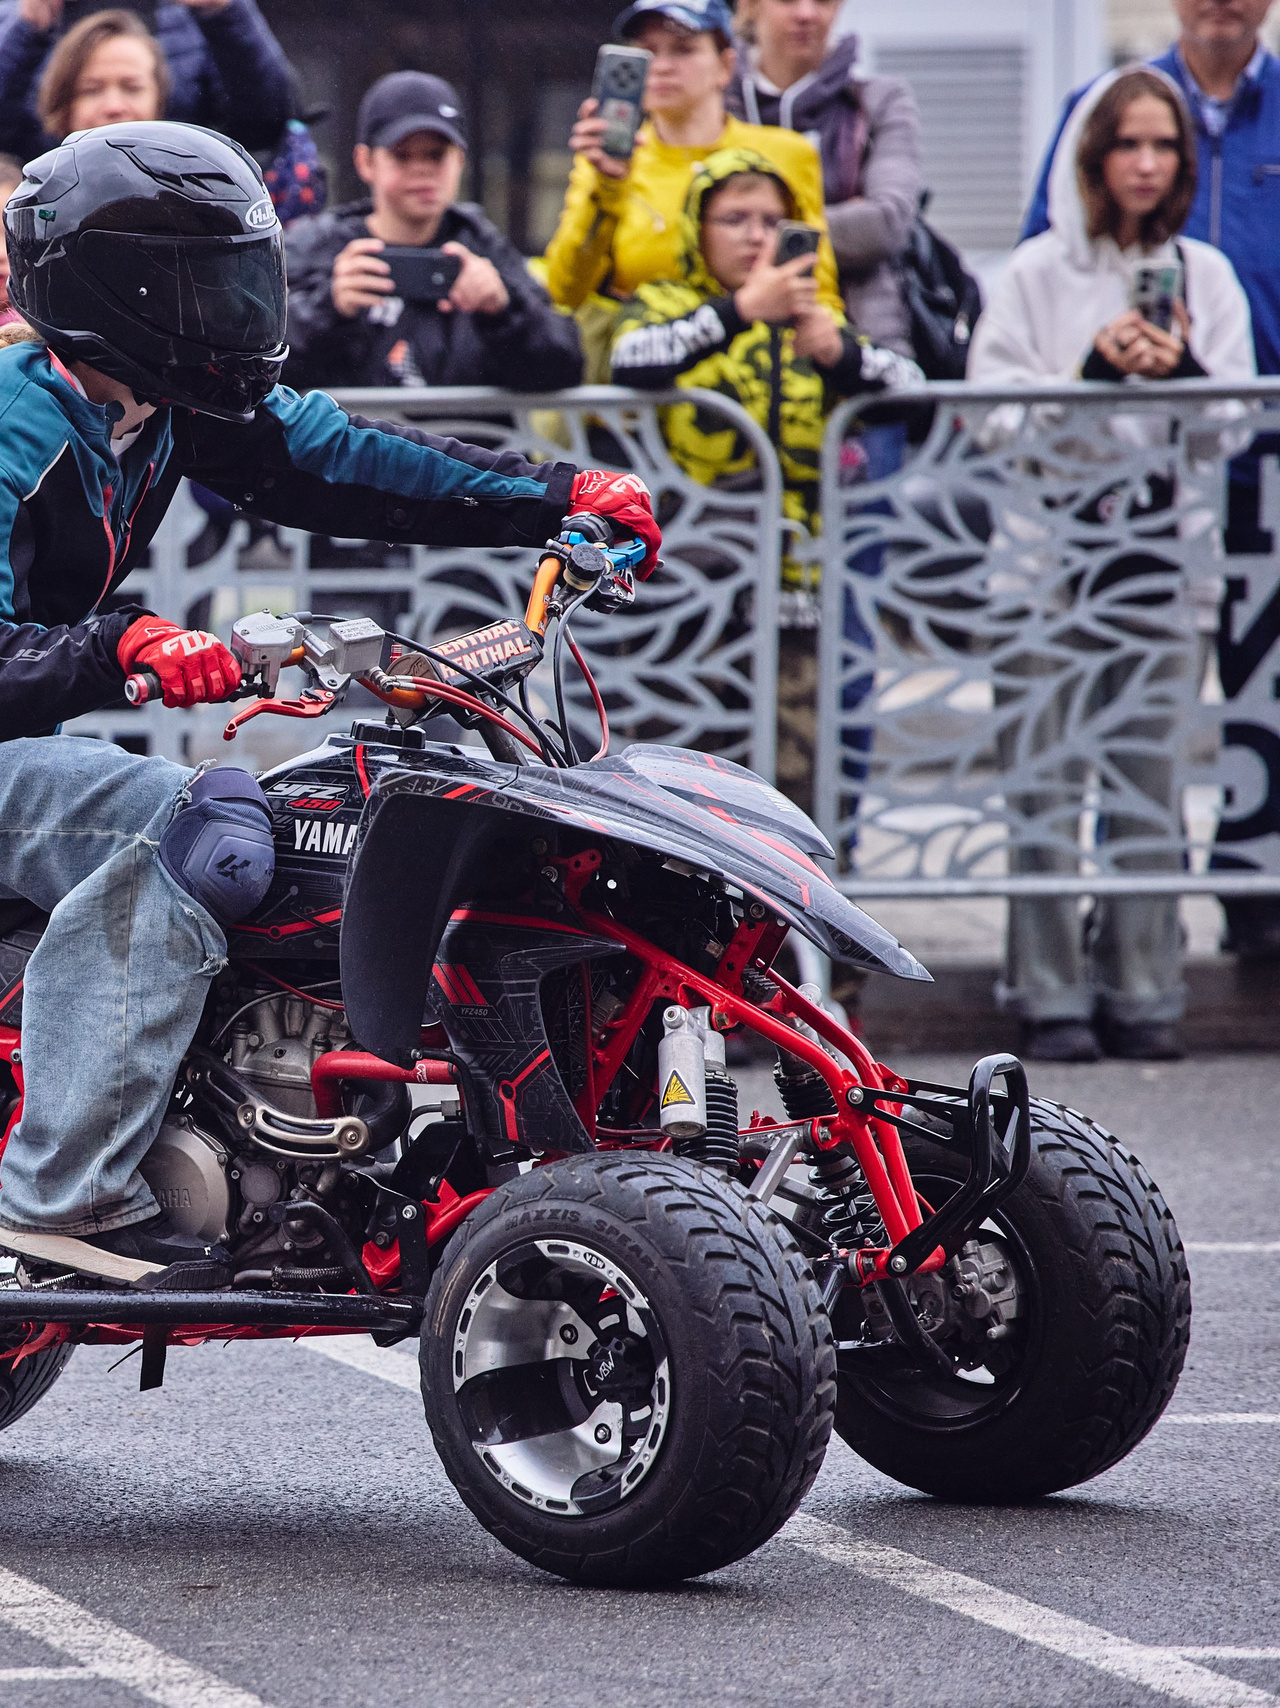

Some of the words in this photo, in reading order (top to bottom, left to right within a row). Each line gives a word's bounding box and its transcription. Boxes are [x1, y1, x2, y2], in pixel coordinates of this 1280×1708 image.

[609, 473, 652, 498] FO
[162, 629, 222, 657] FOX
[431, 621, 521, 657] ENTHAL
[265, 782, 348, 800] YFZ
[287, 798, 343, 811] 450
[461, 1007, 489, 1016] YFZ450
[154, 1188, 192, 1208] AHA
[504, 1208, 581, 1232] MAXXIS
[585, 1252, 606, 1270] VBW
[594, 1350, 615, 1382] VBW
